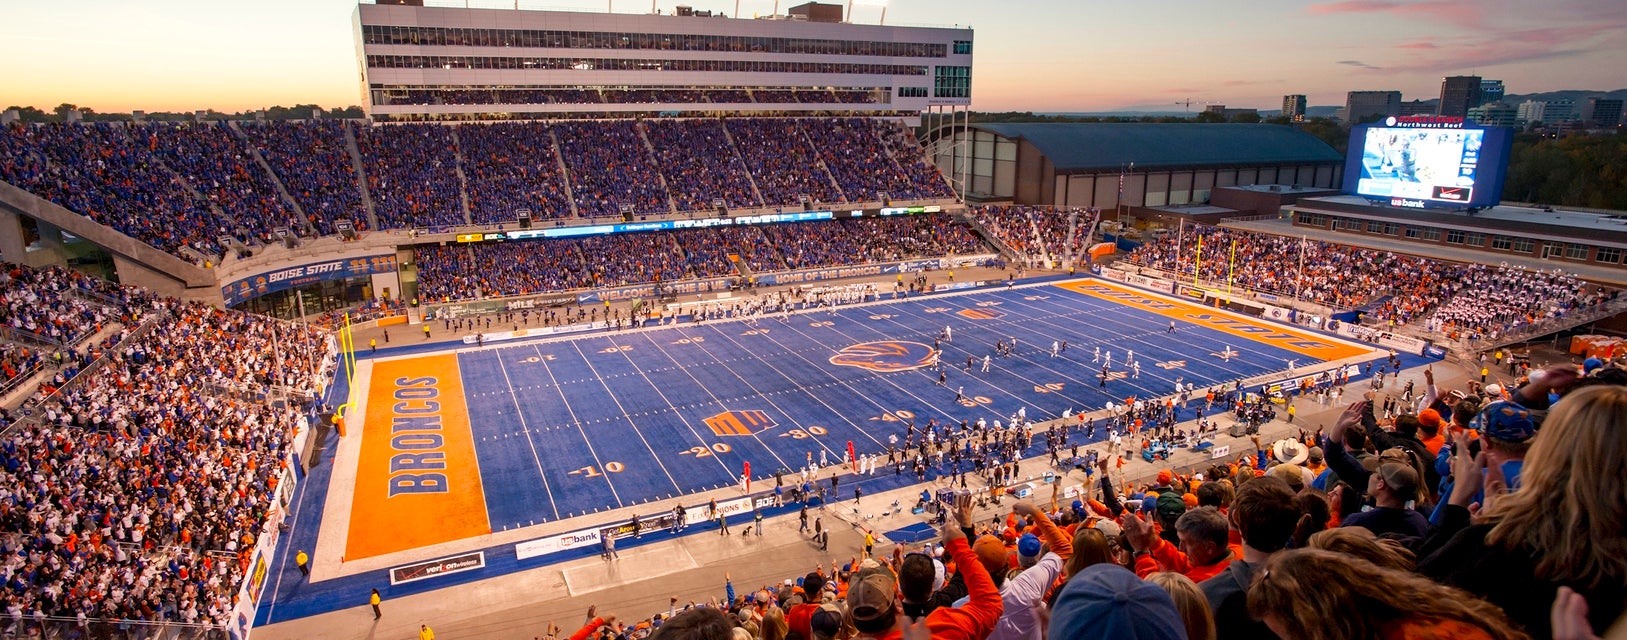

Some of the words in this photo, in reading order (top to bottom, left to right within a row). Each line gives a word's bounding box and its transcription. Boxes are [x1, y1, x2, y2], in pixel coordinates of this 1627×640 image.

[269, 267, 304, 283] BOISE
[306, 261, 343, 275] STATE
[290, 276, 321, 285] FOOTBALL
[775, 273, 803, 284] HOME
[805, 272, 819, 280] OF
[820, 270, 838, 279] THE
[839, 266, 880, 278] BRONCOS
[597, 286, 655, 301] WELCOME
[675, 283, 697, 293] THE
[1078, 284, 1189, 310] BOISE
[1186, 312, 1338, 350] STATE
[388, 376, 449, 498] BRONCOS
[690, 442, 732, 458] 20
[584, 461, 625, 478] 10
